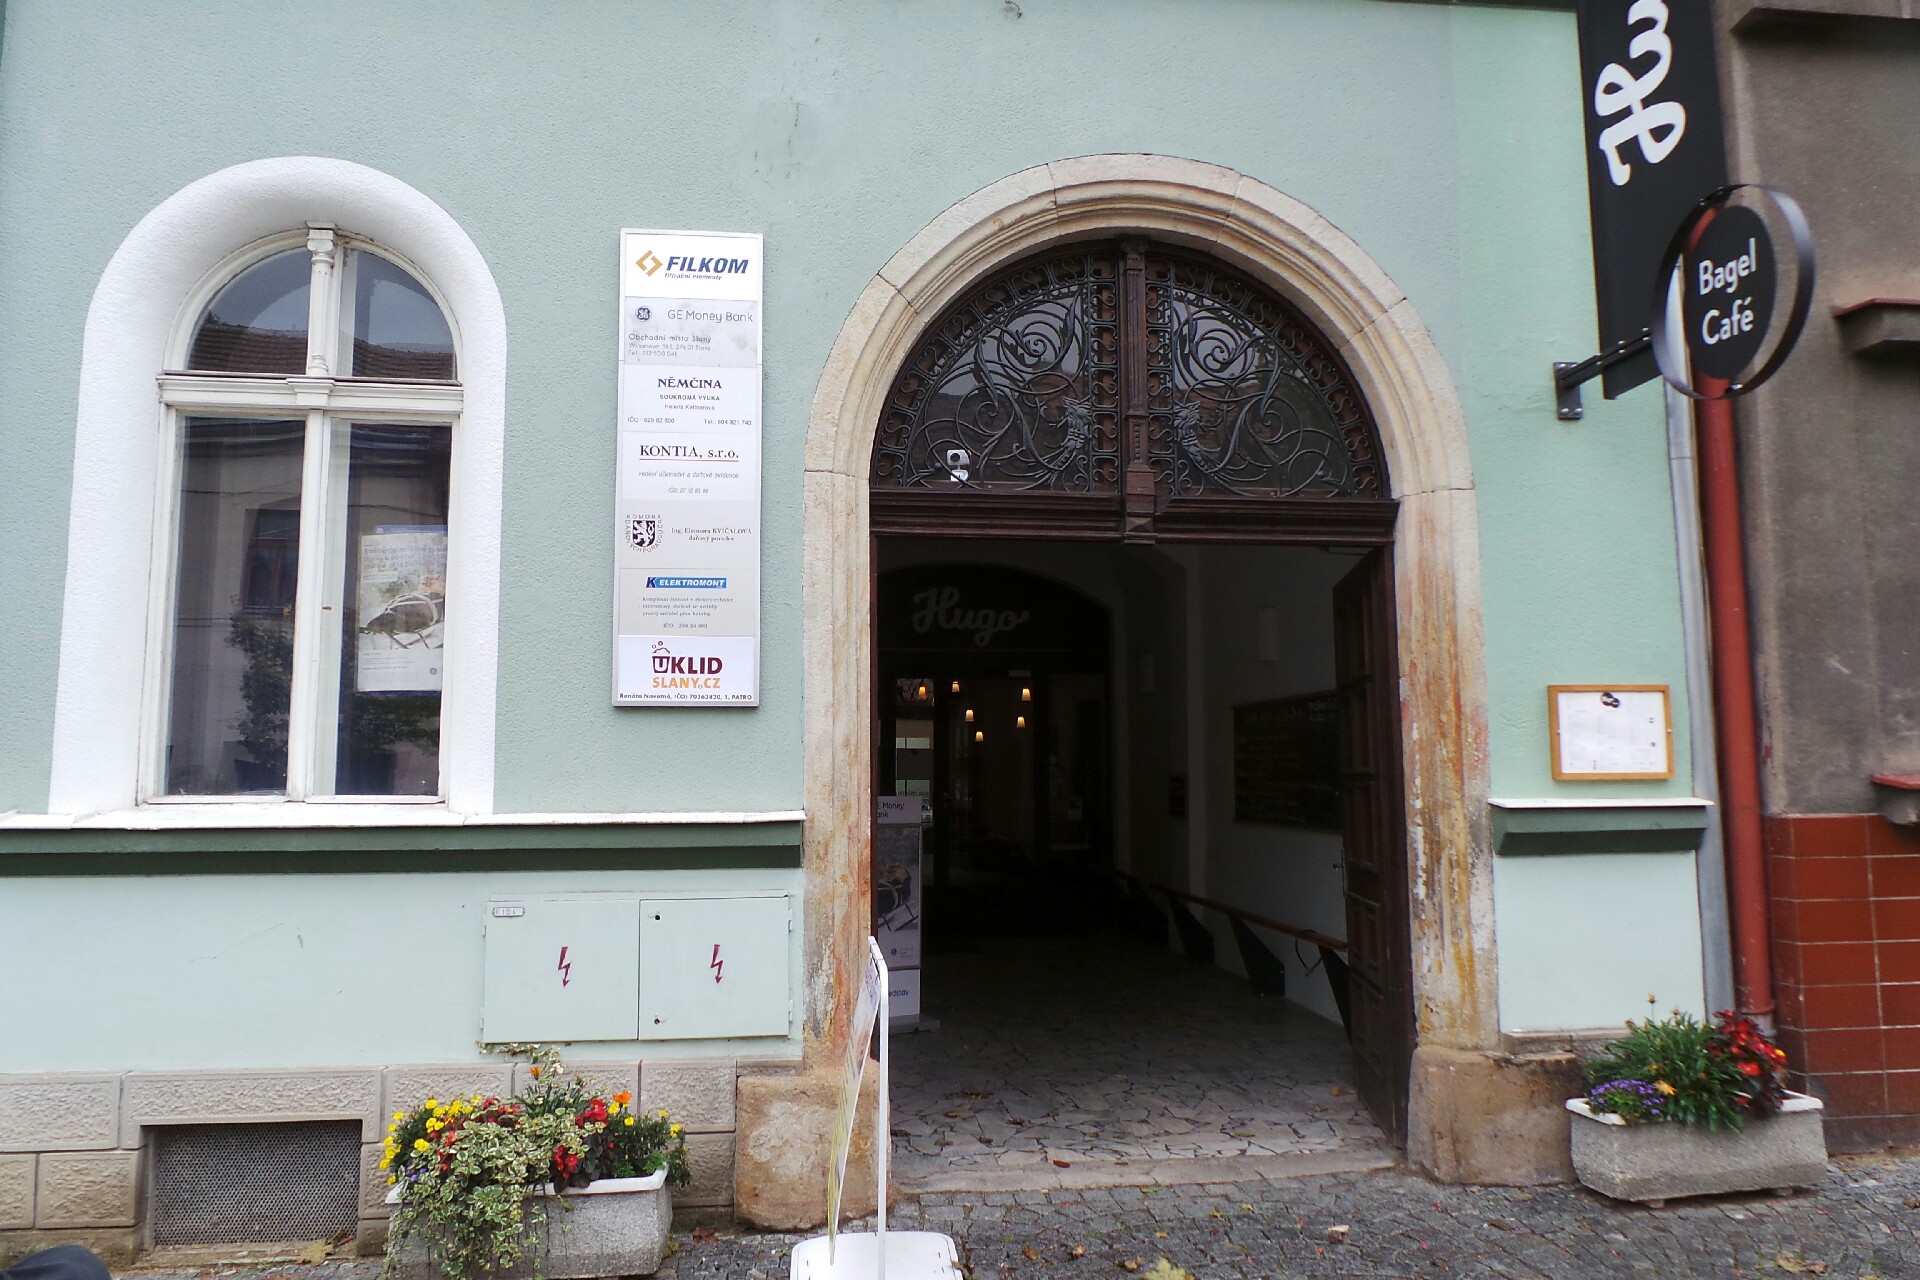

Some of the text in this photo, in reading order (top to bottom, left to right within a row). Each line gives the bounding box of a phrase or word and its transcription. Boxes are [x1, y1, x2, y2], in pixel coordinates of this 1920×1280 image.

[666, 256, 749, 274] FILKOM
[1699, 238, 1756, 295] Bagel
[667, 309, 754, 324] GE Money Bank
[1702, 297, 1755, 346] Café
[628, 333, 711, 343] Obchodní místo Slaný
[657, 376, 723, 389] NĚMČINA
[640, 444, 739, 459] KONTIA, s.r.o.
[659, 579, 725, 587] ELEKTROMONT
[912, 586, 1031, 648] Hugo
[652, 676, 721, 690] SLANY.CZ
[882, 802, 905, 810] Money
